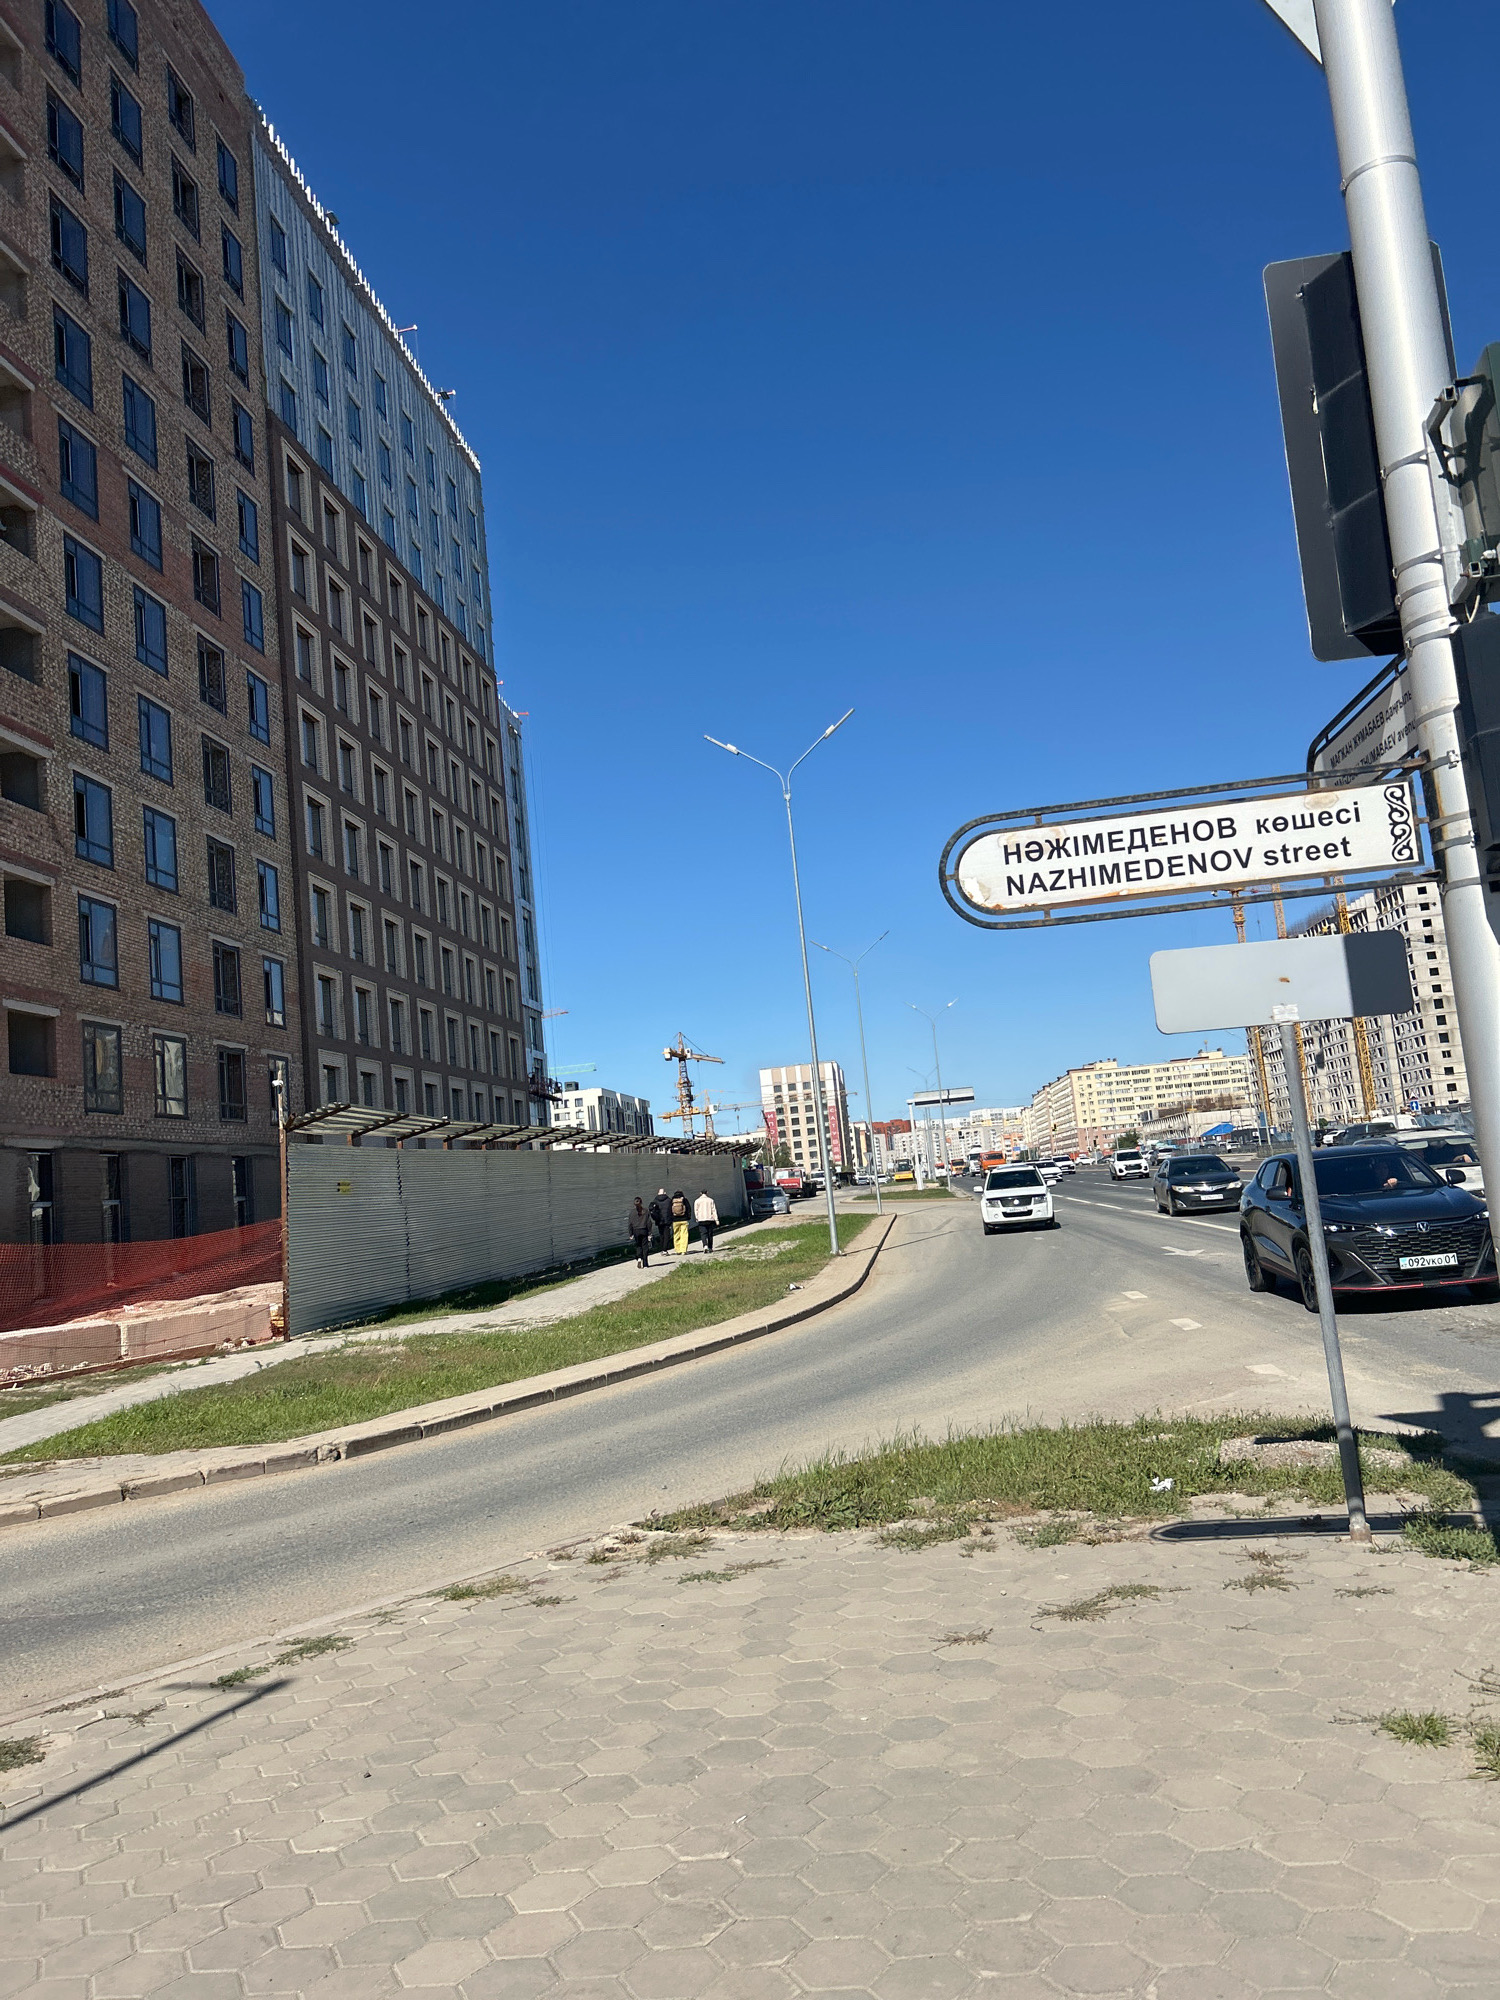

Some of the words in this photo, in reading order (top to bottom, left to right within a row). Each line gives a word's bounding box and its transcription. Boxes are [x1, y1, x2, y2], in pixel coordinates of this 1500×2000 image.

[1003, 817, 1237, 865] НӘЖІМЕДЕНОВ
[1256, 801, 1361, 835] көшесі
[1006, 846, 1253, 896] NAZHIMEDENOV
[1263, 836, 1352, 866] street
[1445, 1254, 1457, 1264] 01
